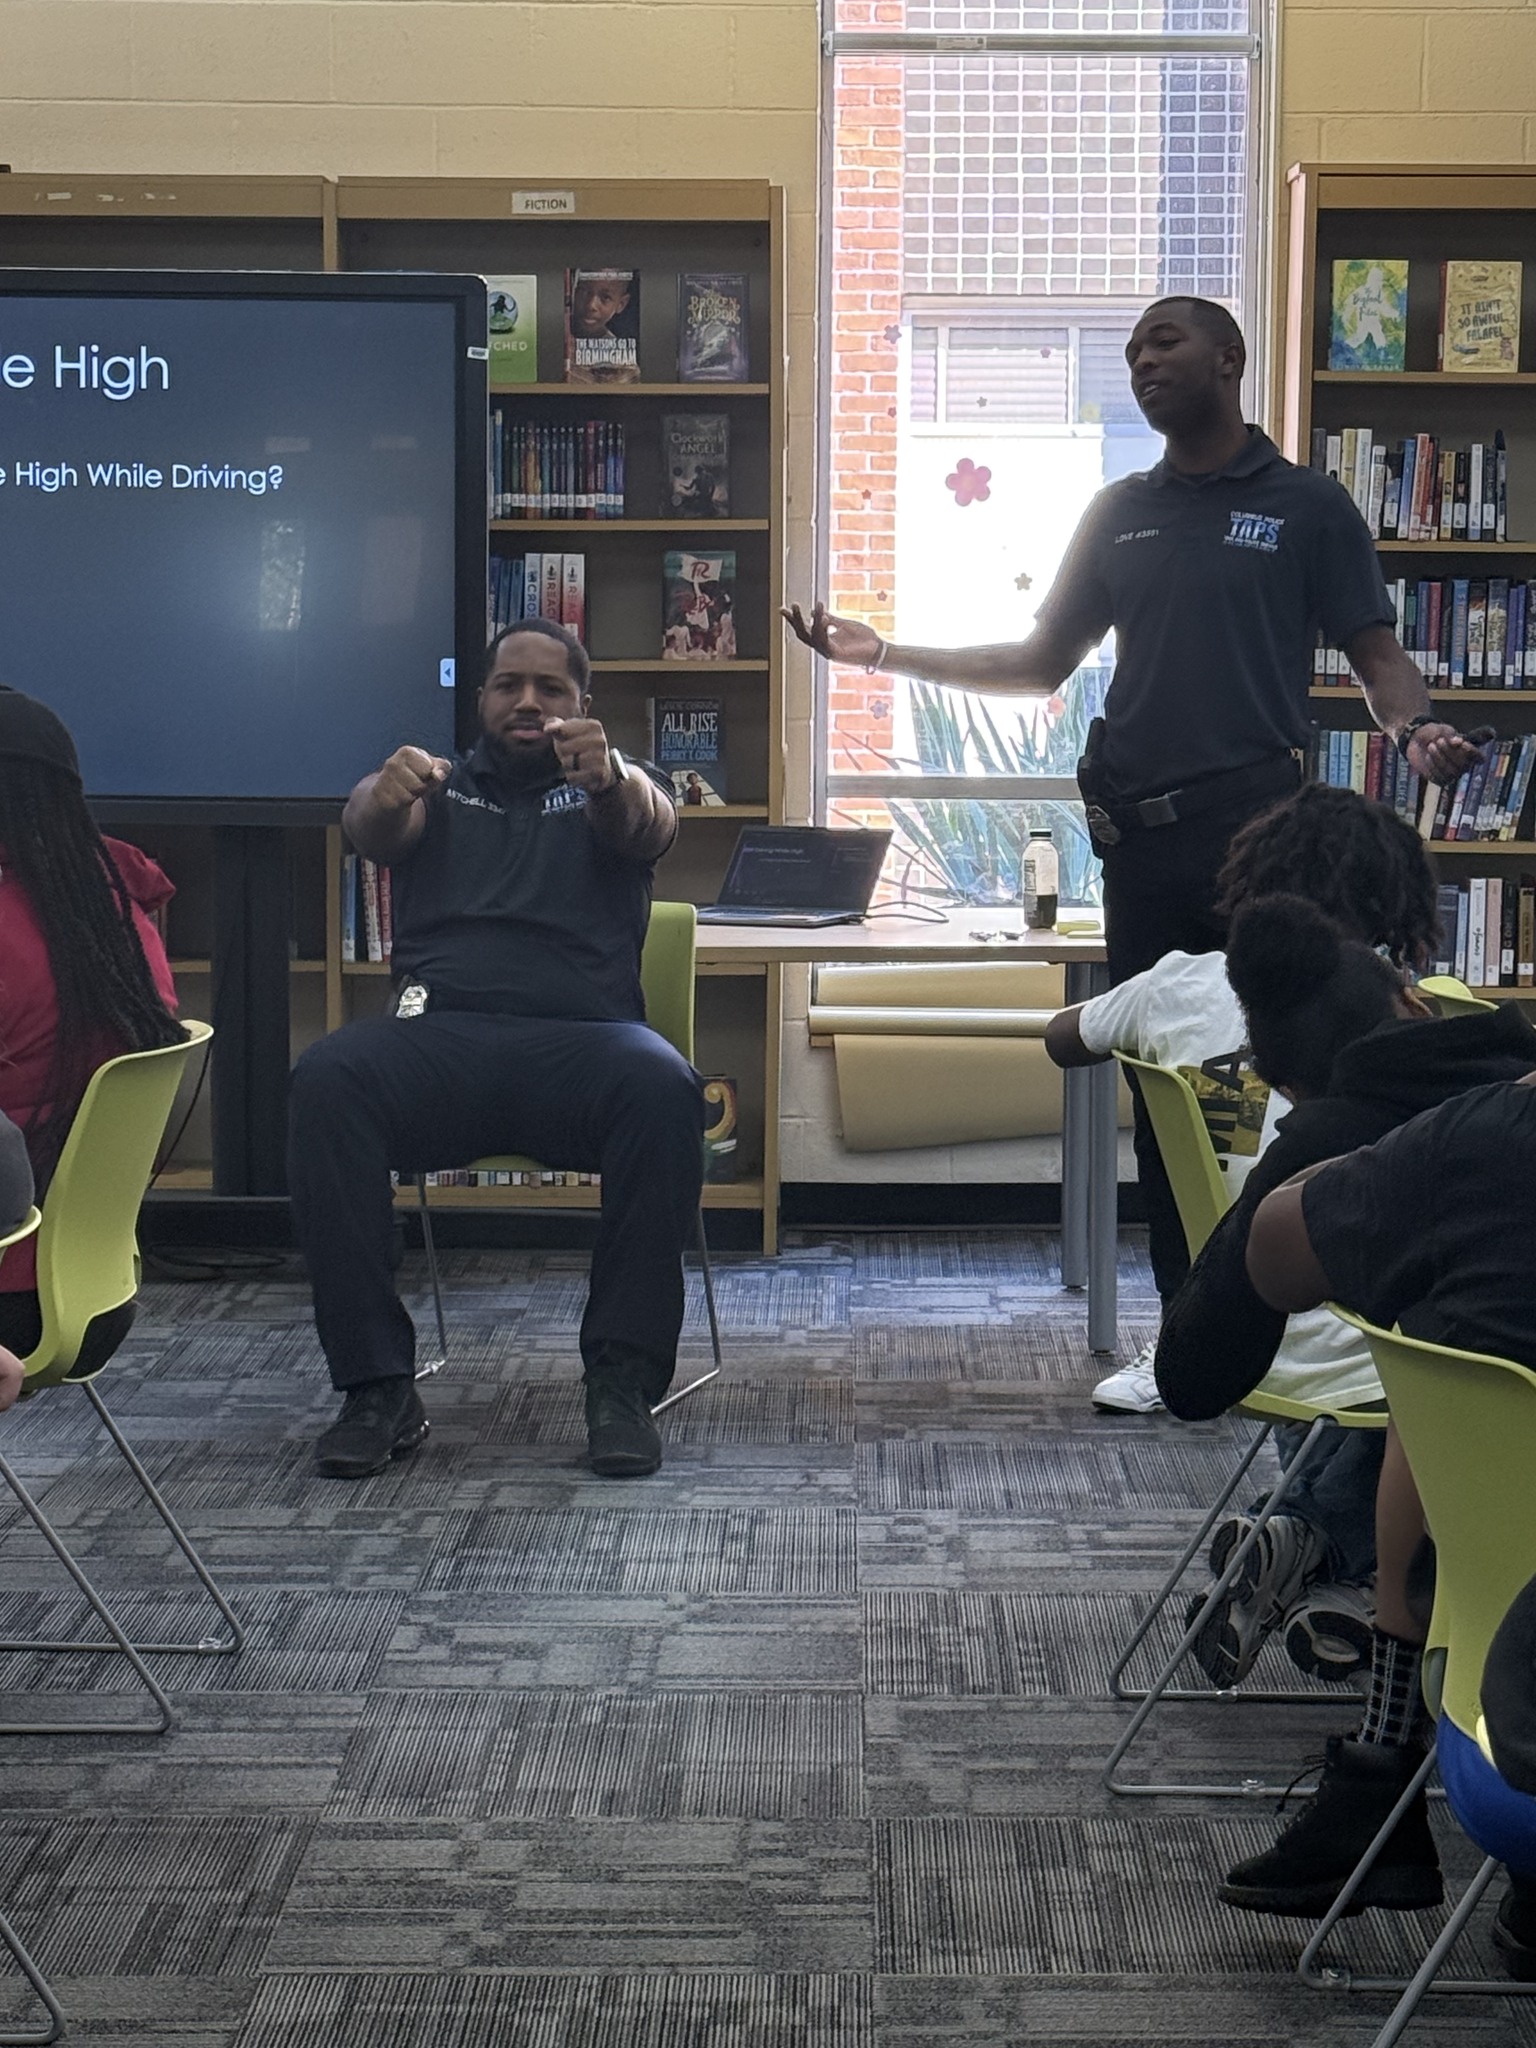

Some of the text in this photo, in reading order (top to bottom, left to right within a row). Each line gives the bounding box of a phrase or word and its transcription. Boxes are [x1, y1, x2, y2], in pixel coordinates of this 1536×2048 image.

[524, 198, 567, 210] FICTION
[1461, 303, 1471, 315] IT
[1472, 313, 1509, 327] AWFUL
[1466, 326, 1506, 342] FALAFEL
[576, 338, 637, 349] THE WATSONS GO TO
[575, 349, 637, 366] BIRMINGHAM
[54, 344, 169, 400] High
[680, 443, 715, 454] ANGEL
[15, 461, 78, 492] High
[86, 463, 163, 488] While
[172, 464, 284, 495] Driving?
[1230, 517, 1279, 545] TAPS
[661, 712, 718, 733] ALL RISE
[661, 732, 718, 750] HONORABLE
[695, 750, 718, 761] COOK
[446, 788, 487, 808] MITCHELL
